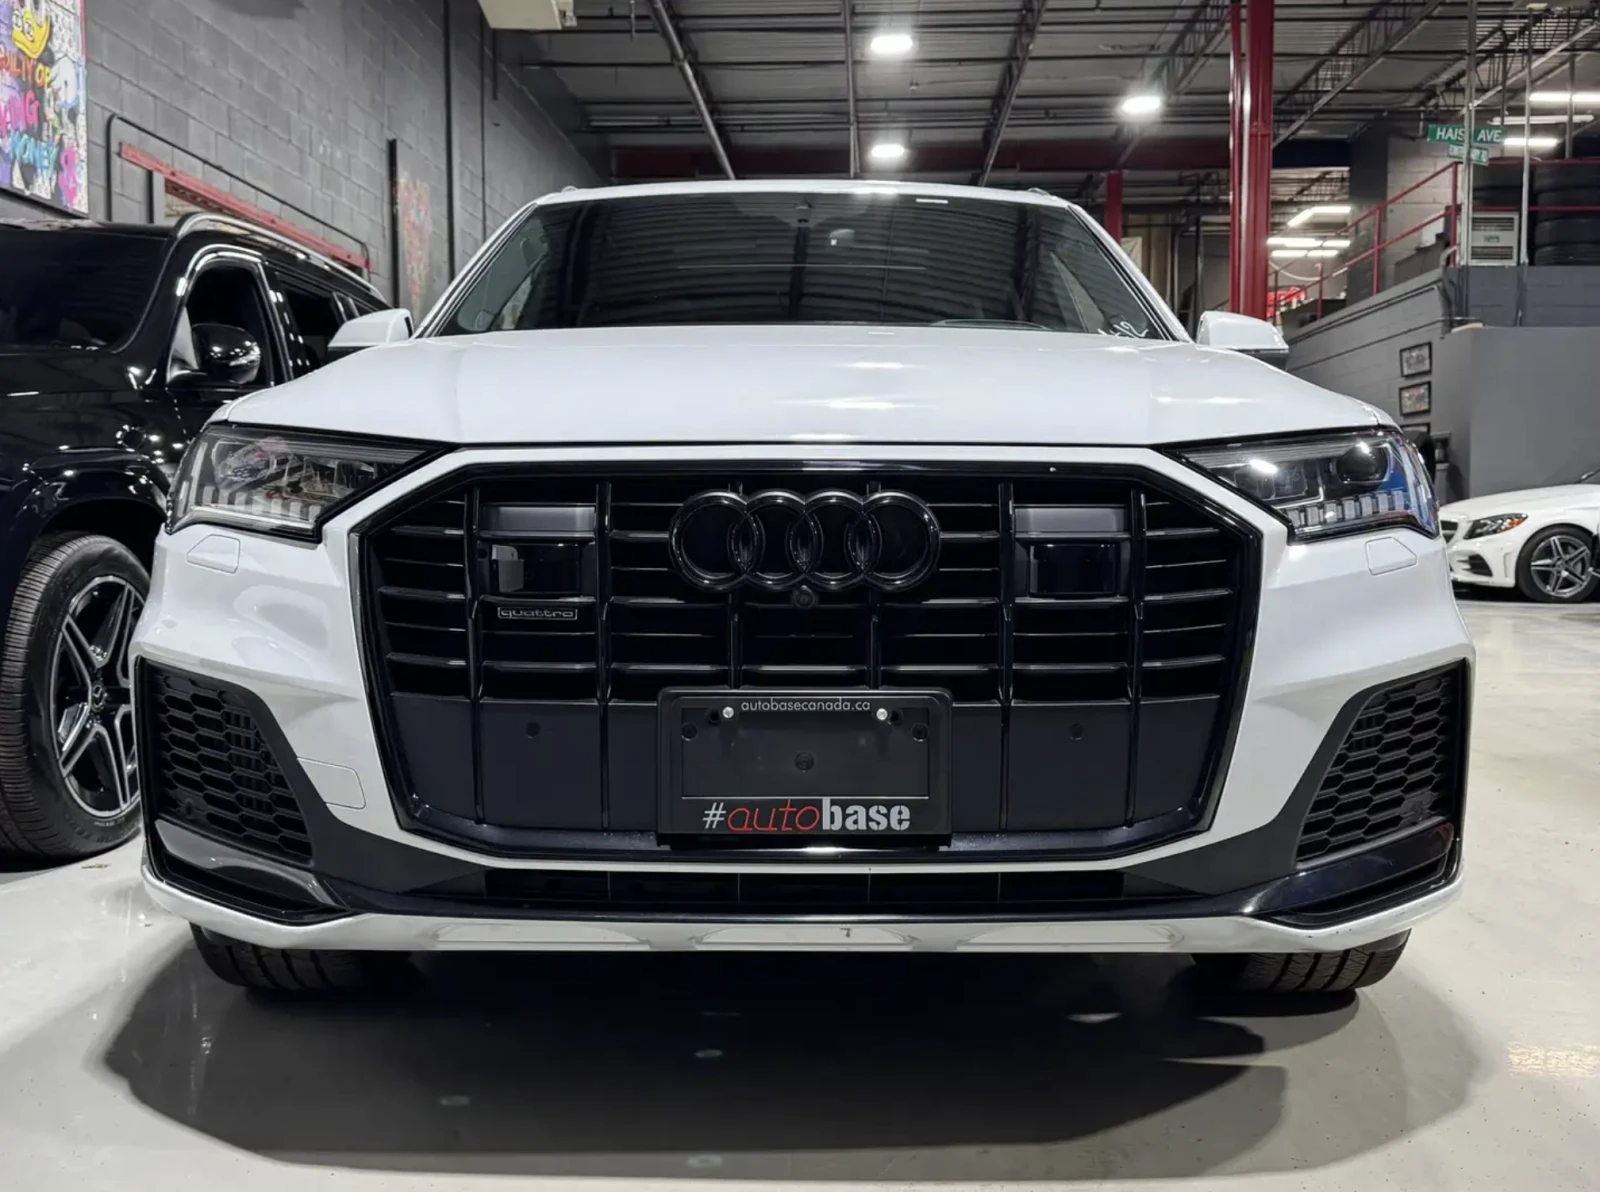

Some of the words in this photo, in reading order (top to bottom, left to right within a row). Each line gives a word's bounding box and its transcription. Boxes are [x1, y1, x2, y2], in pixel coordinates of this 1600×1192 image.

[1436, 127, 1468, 141] HAIS
[1477, 129, 1502, 142] AVE
[500, 609, 574, 618] quattro
[741, 698, 871, 711] autobasecanada.ca
[702, 798, 911, 832] #autobase
